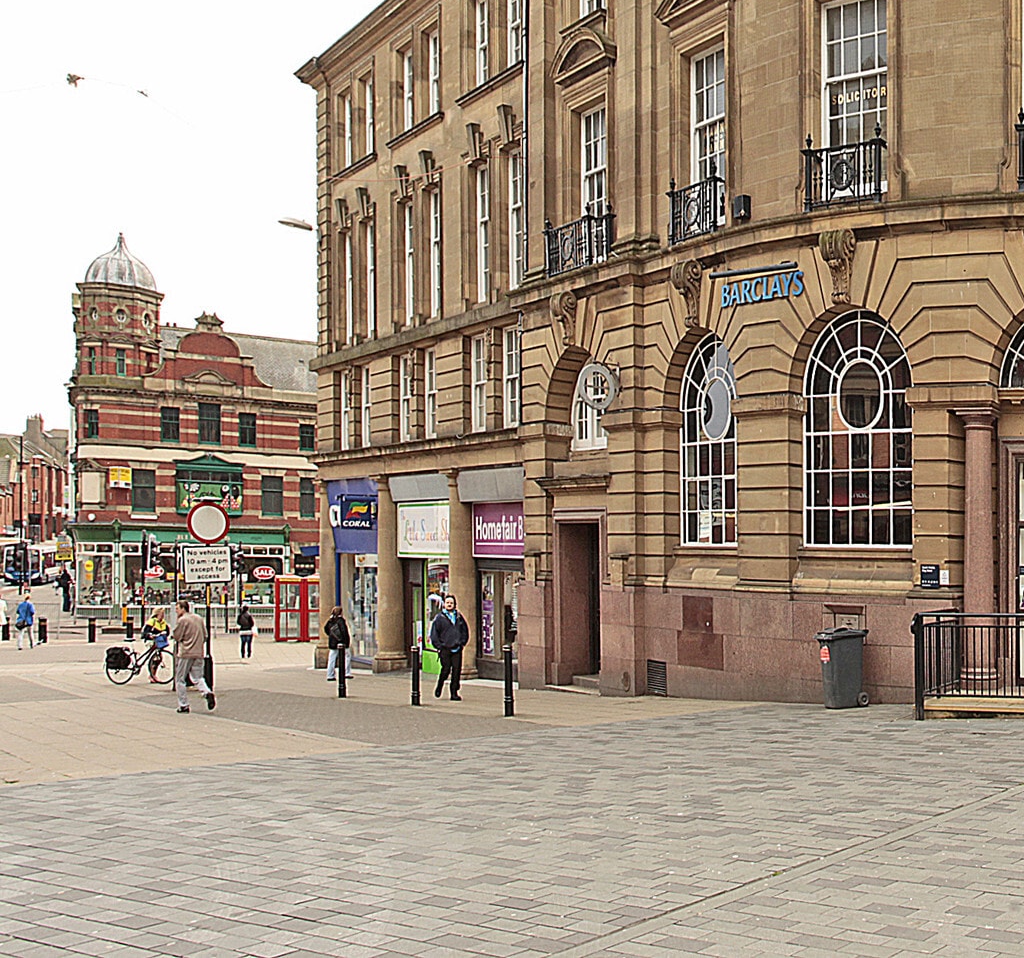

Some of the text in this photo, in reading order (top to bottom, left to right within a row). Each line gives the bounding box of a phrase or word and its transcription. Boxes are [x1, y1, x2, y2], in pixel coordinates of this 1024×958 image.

[832, 86, 886, 105] SOLICITOR
[721, 271, 804, 308] BARCLAYS
[342, 520, 371, 528] CORAL
[475, 515, 526, 540] Homefair B
